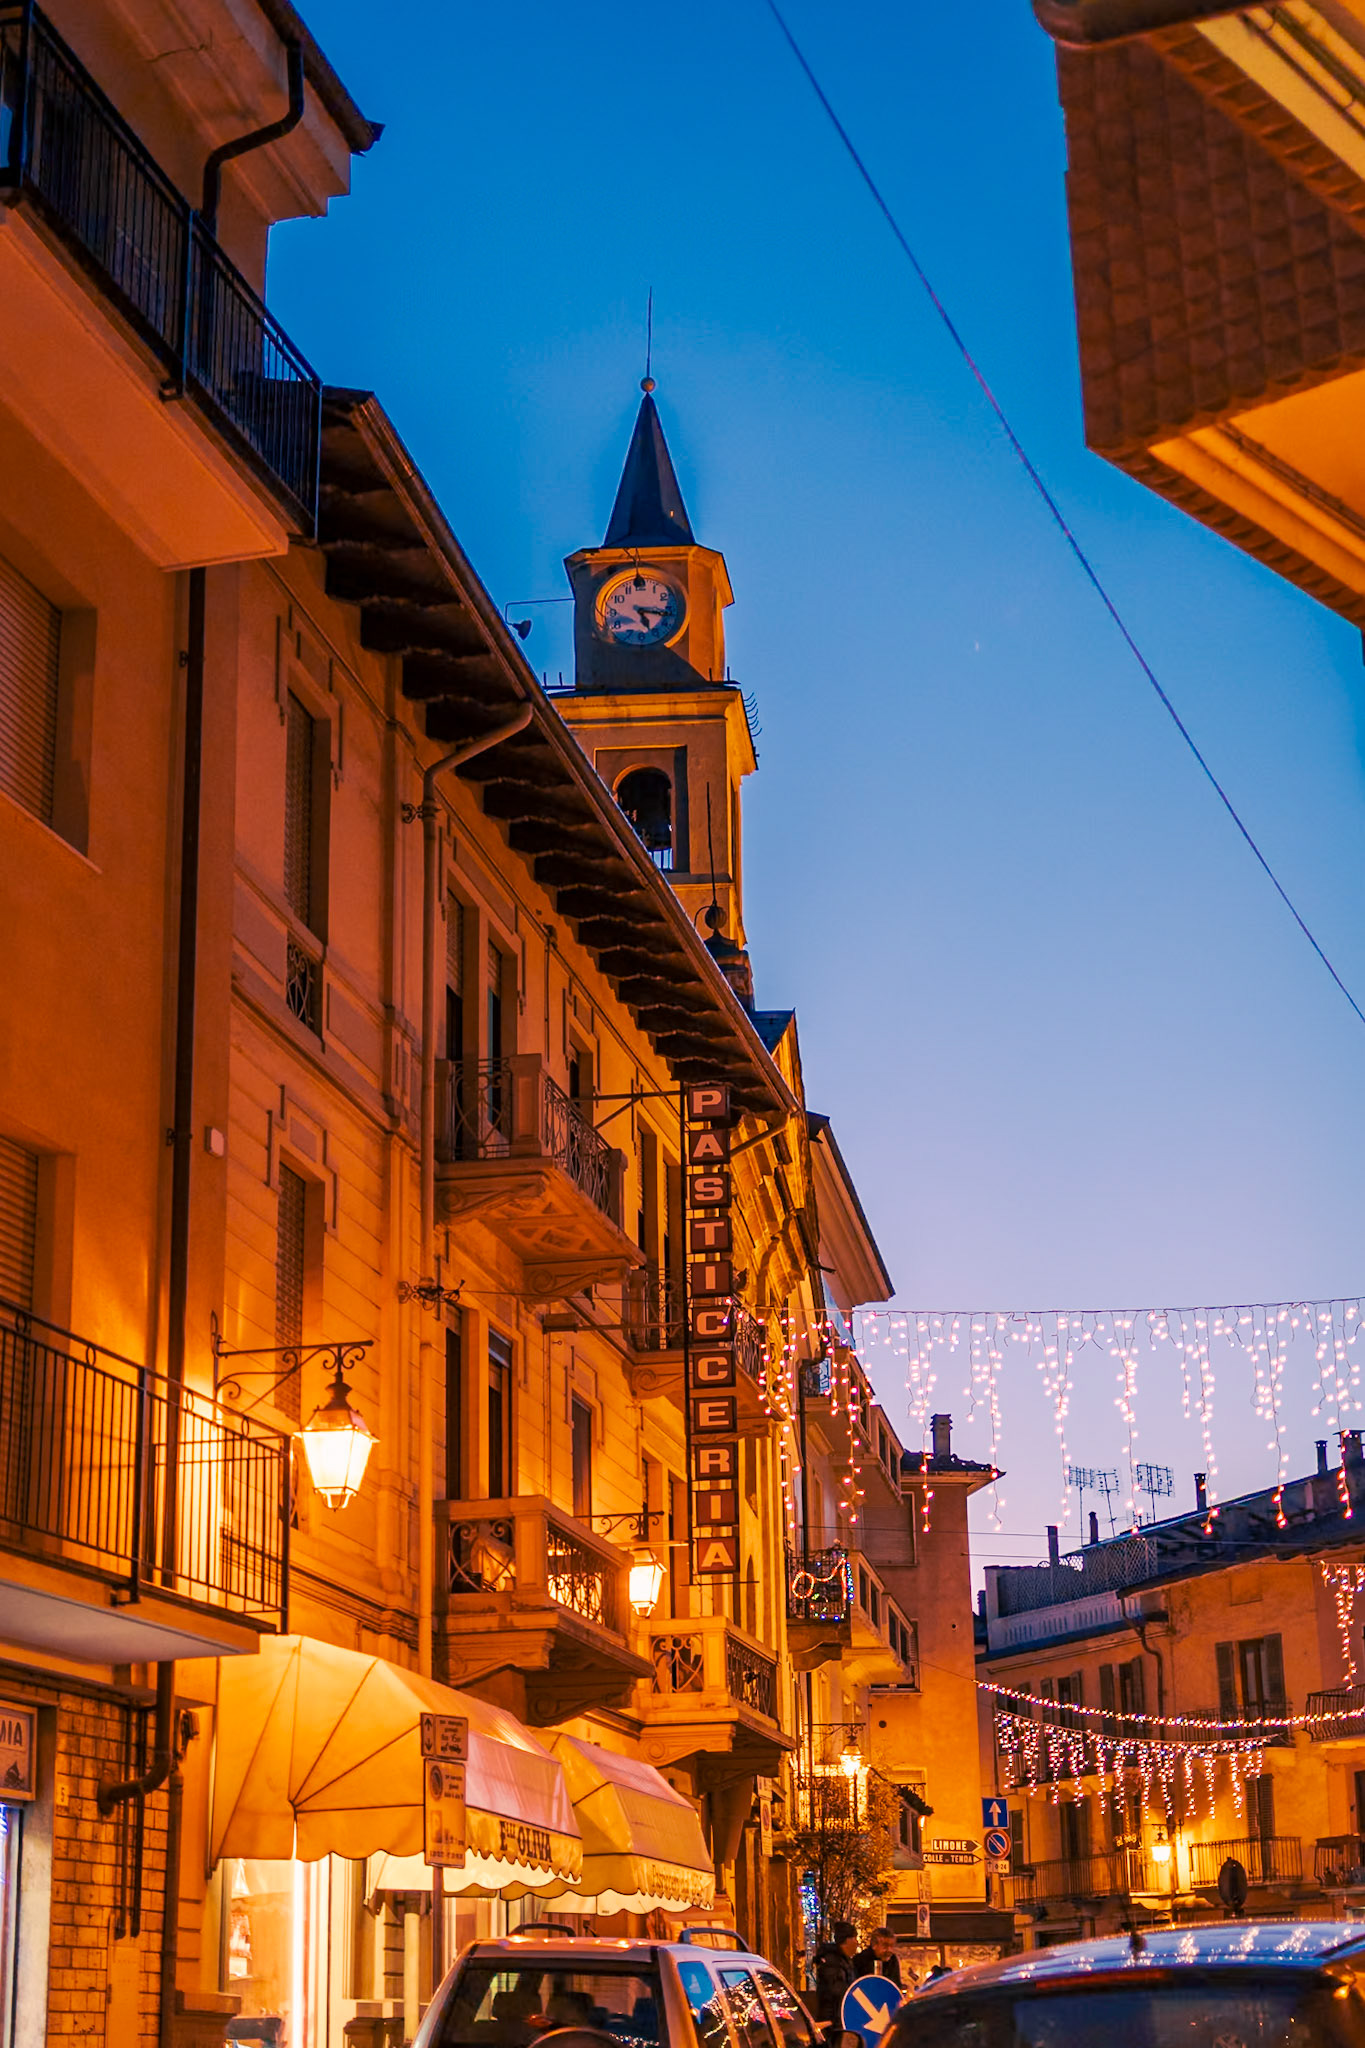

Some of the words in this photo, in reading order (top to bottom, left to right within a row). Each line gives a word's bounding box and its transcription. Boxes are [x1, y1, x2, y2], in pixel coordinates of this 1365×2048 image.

[625, 586, 632, 595] 11
[613, 594, 625, 604] 10
[660, 592, 668, 602] 2
[609, 608, 617, 618] 9
[613, 620, 621, 630] 8
[625, 629, 634, 641] 7
[637, 632, 646, 642] 6
[692, 1089, 735, 1569] PASTICCERIA
[517, 1826, 553, 1863] OLIVA
[933, 1840, 968, 1851] LIMONE
[922, 1854, 944, 1863] COLLE
[949, 1855, 973, 1863] TENDA
